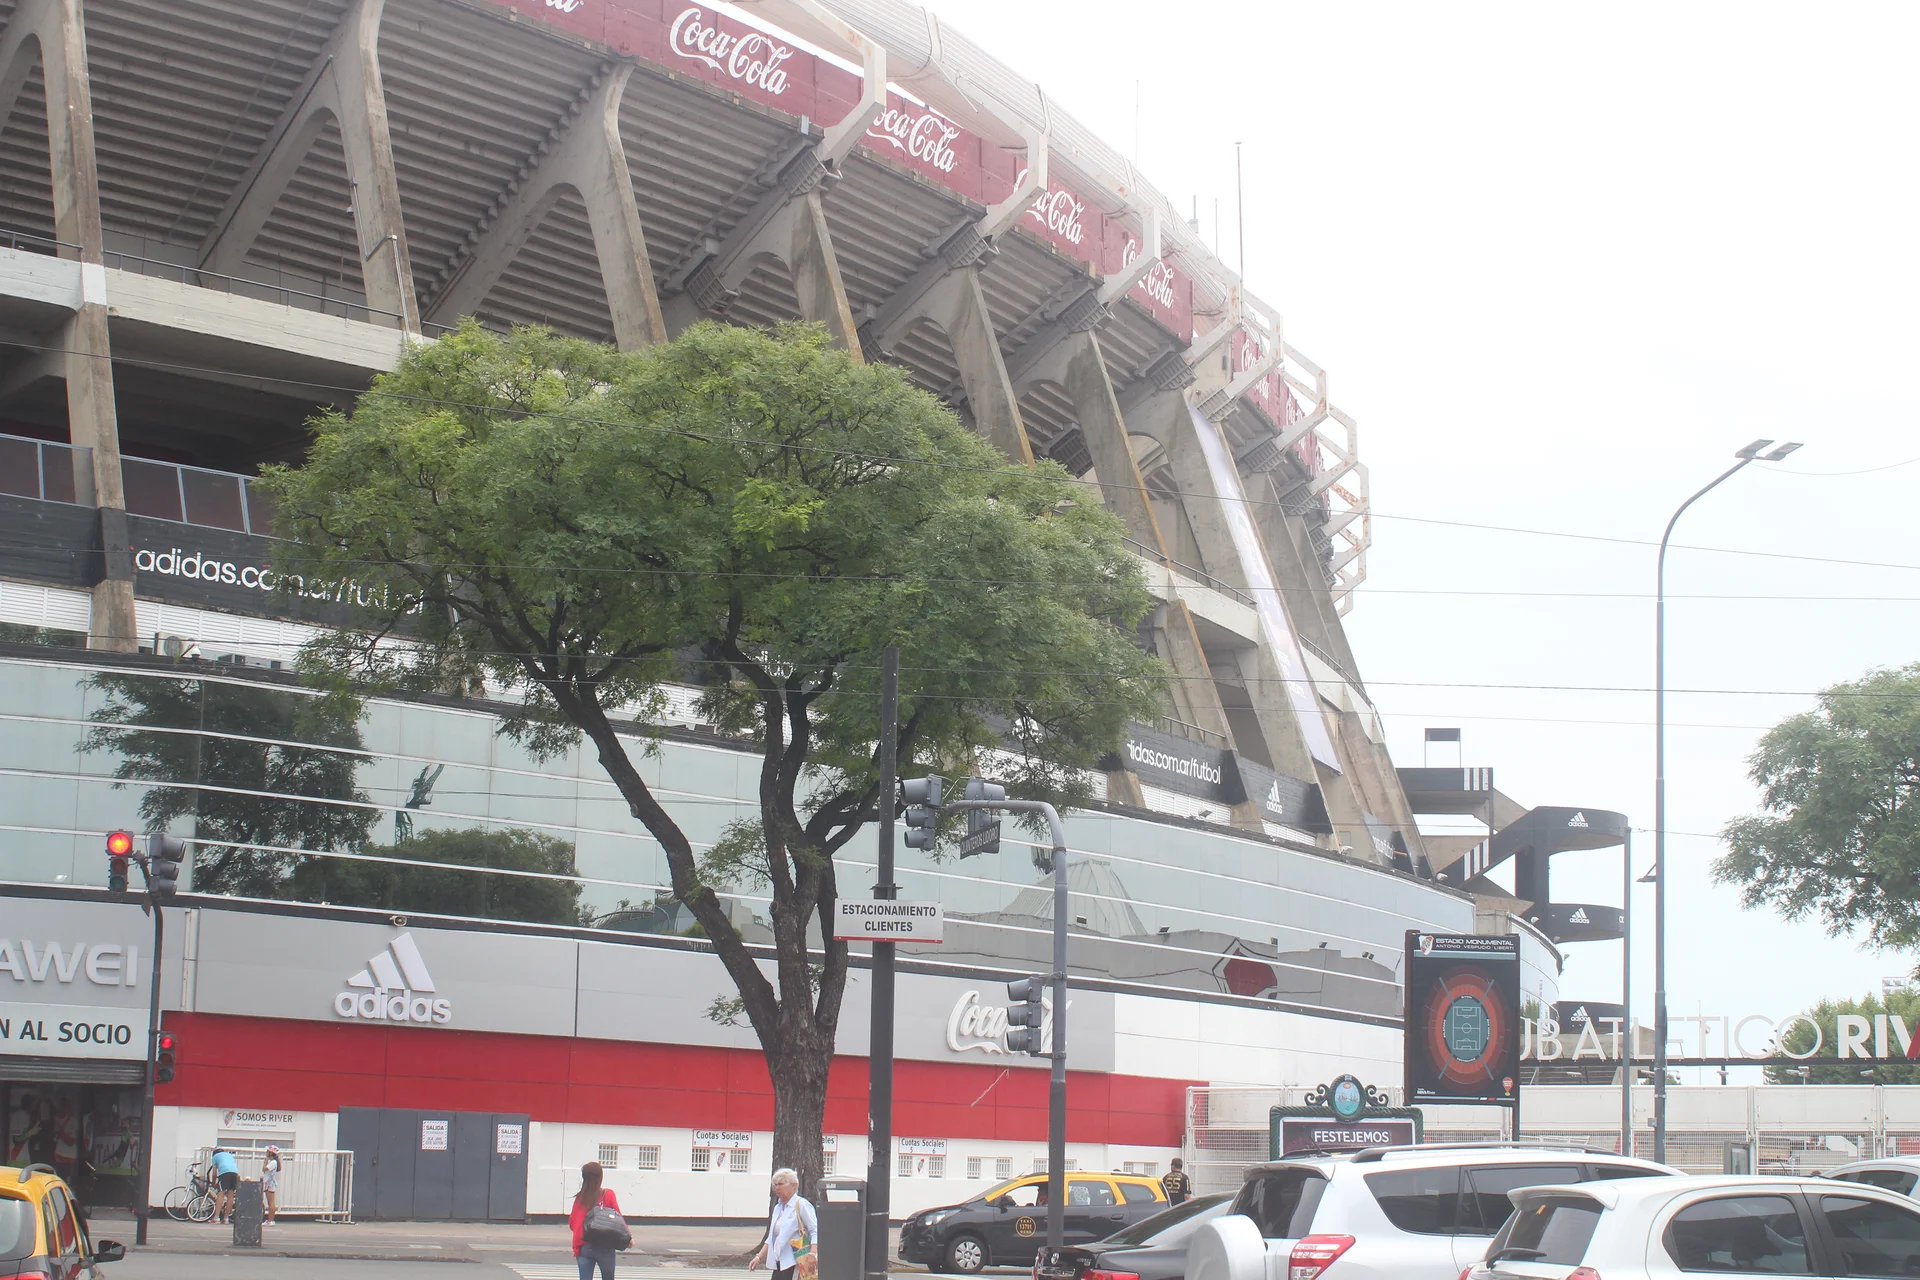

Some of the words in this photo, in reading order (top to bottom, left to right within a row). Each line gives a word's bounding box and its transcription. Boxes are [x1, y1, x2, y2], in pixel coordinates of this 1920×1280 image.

[669, 7, 793, 96] Coca-Cola
[866, 108, 960, 173] oca-Cola
[1266, 800, 1283, 815] adidas
[842, 904, 936, 917] ESTACIONAMIENTO
[864, 920, 913, 932] CLIENTES
[1465, 938, 1514, 946] MONUMENTAL
[0, 939, 138, 986] AWEI
[334, 986, 452, 1024] adidas
[19, 1019, 49, 1041] AL
[58, 1021, 131, 1045] SOCIO
[1571, 1014, 1823, 1061] ATLETICO
[236, 1112, 267, 1122] SOMOS
[268, 1113, 293, 1123] RIVER
[696, 1131, 720, 1140] Cuotas
[721, 1132, 750, 1141] Sociales
[901, 1138, 920, 1147] Cuotas
[921, 1139, 945, 1148] Sociales
[1314, 1130, 1390, 1143] FESTEJEMOS
